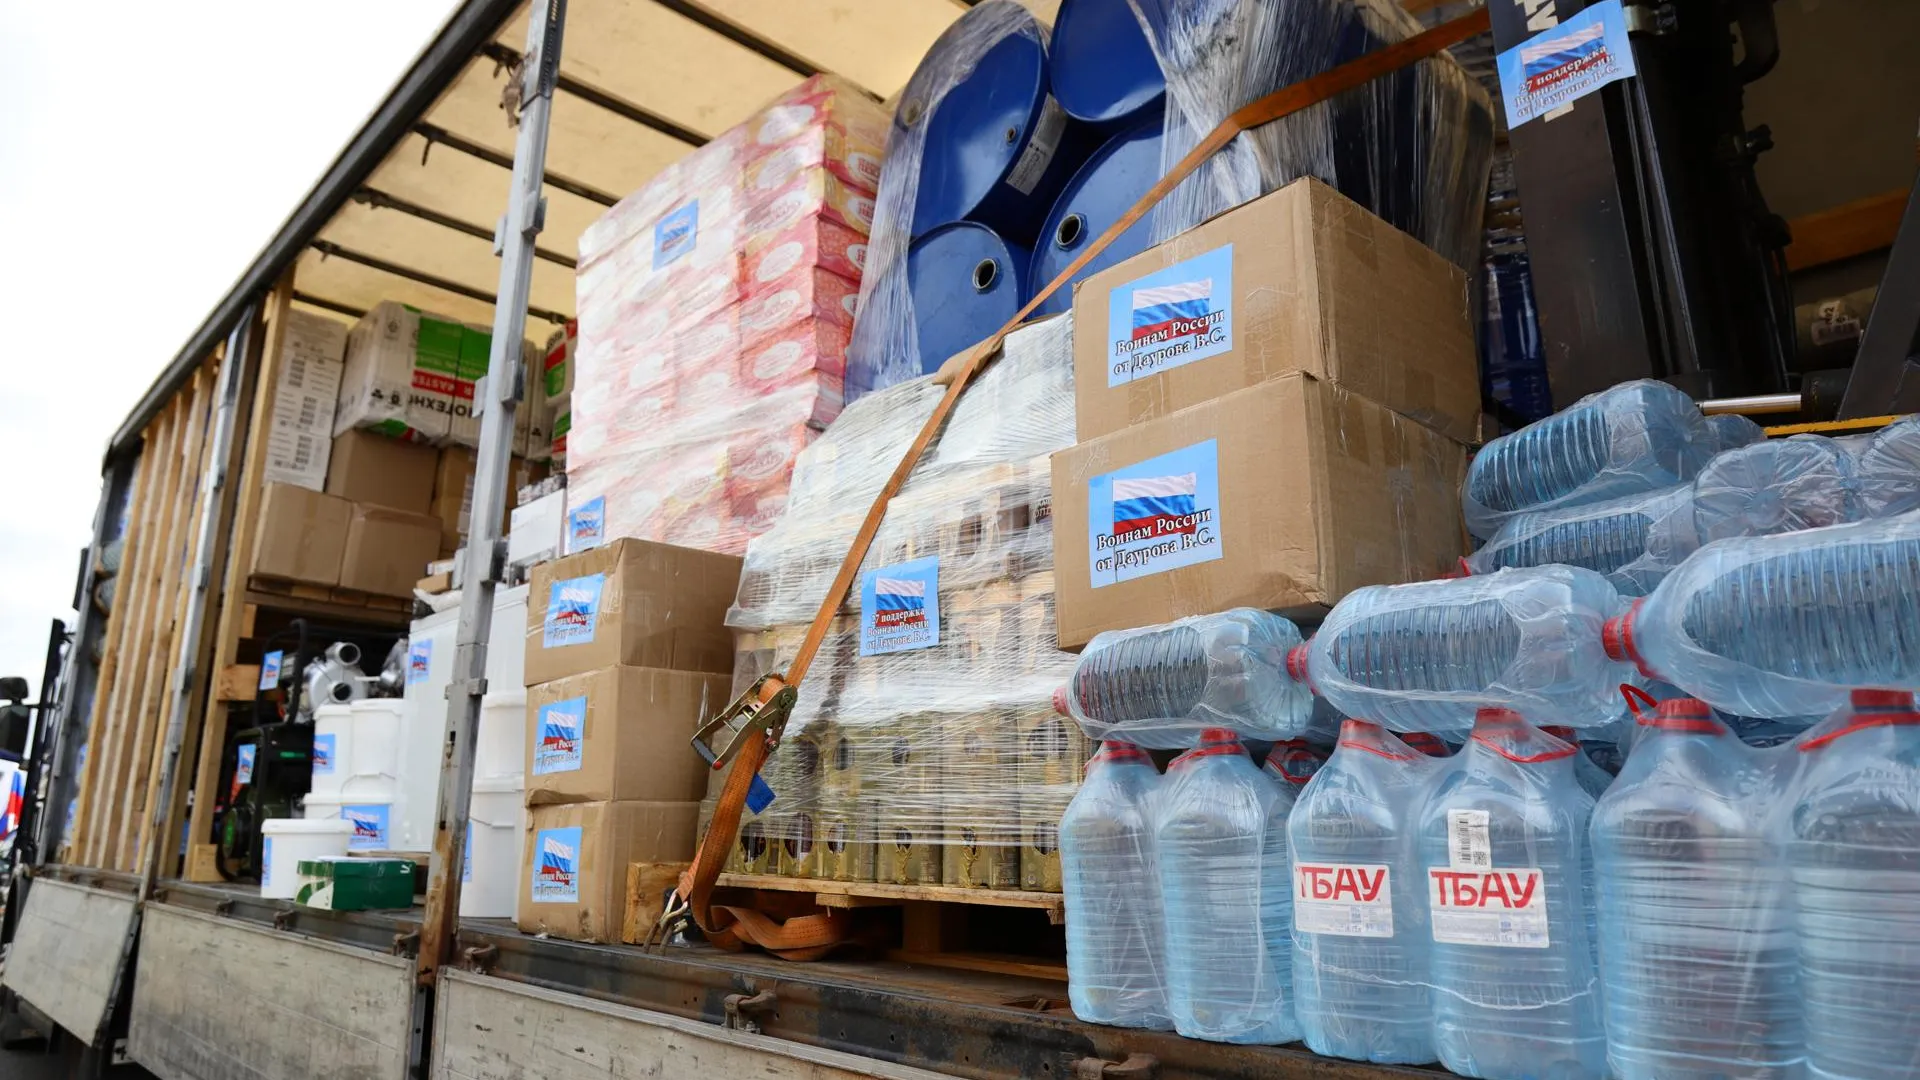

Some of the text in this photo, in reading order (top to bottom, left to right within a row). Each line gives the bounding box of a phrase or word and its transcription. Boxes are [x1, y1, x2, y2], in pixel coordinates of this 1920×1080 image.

[1514, 54, 1617, 108] Воинам России
[1536, 45, 1607, 85] поддержка
[1534, 78, 1592, 110] Даурова
[1113, 327, 1227, 375] от Даурова В.С.
[1116, 310, 1225, 356] Воинам России
[1096, 508, 1212, 552] Воинам России
[1096, 527, 1216, 572] от Даурова В.С.
[867, 620, 929, 638] Воинам России
[881, 608, 925, 623] поддержка
[1295, 866, 1386, 902] ТБАУ
[1430, 871, 1539, 909] ТБАУ
